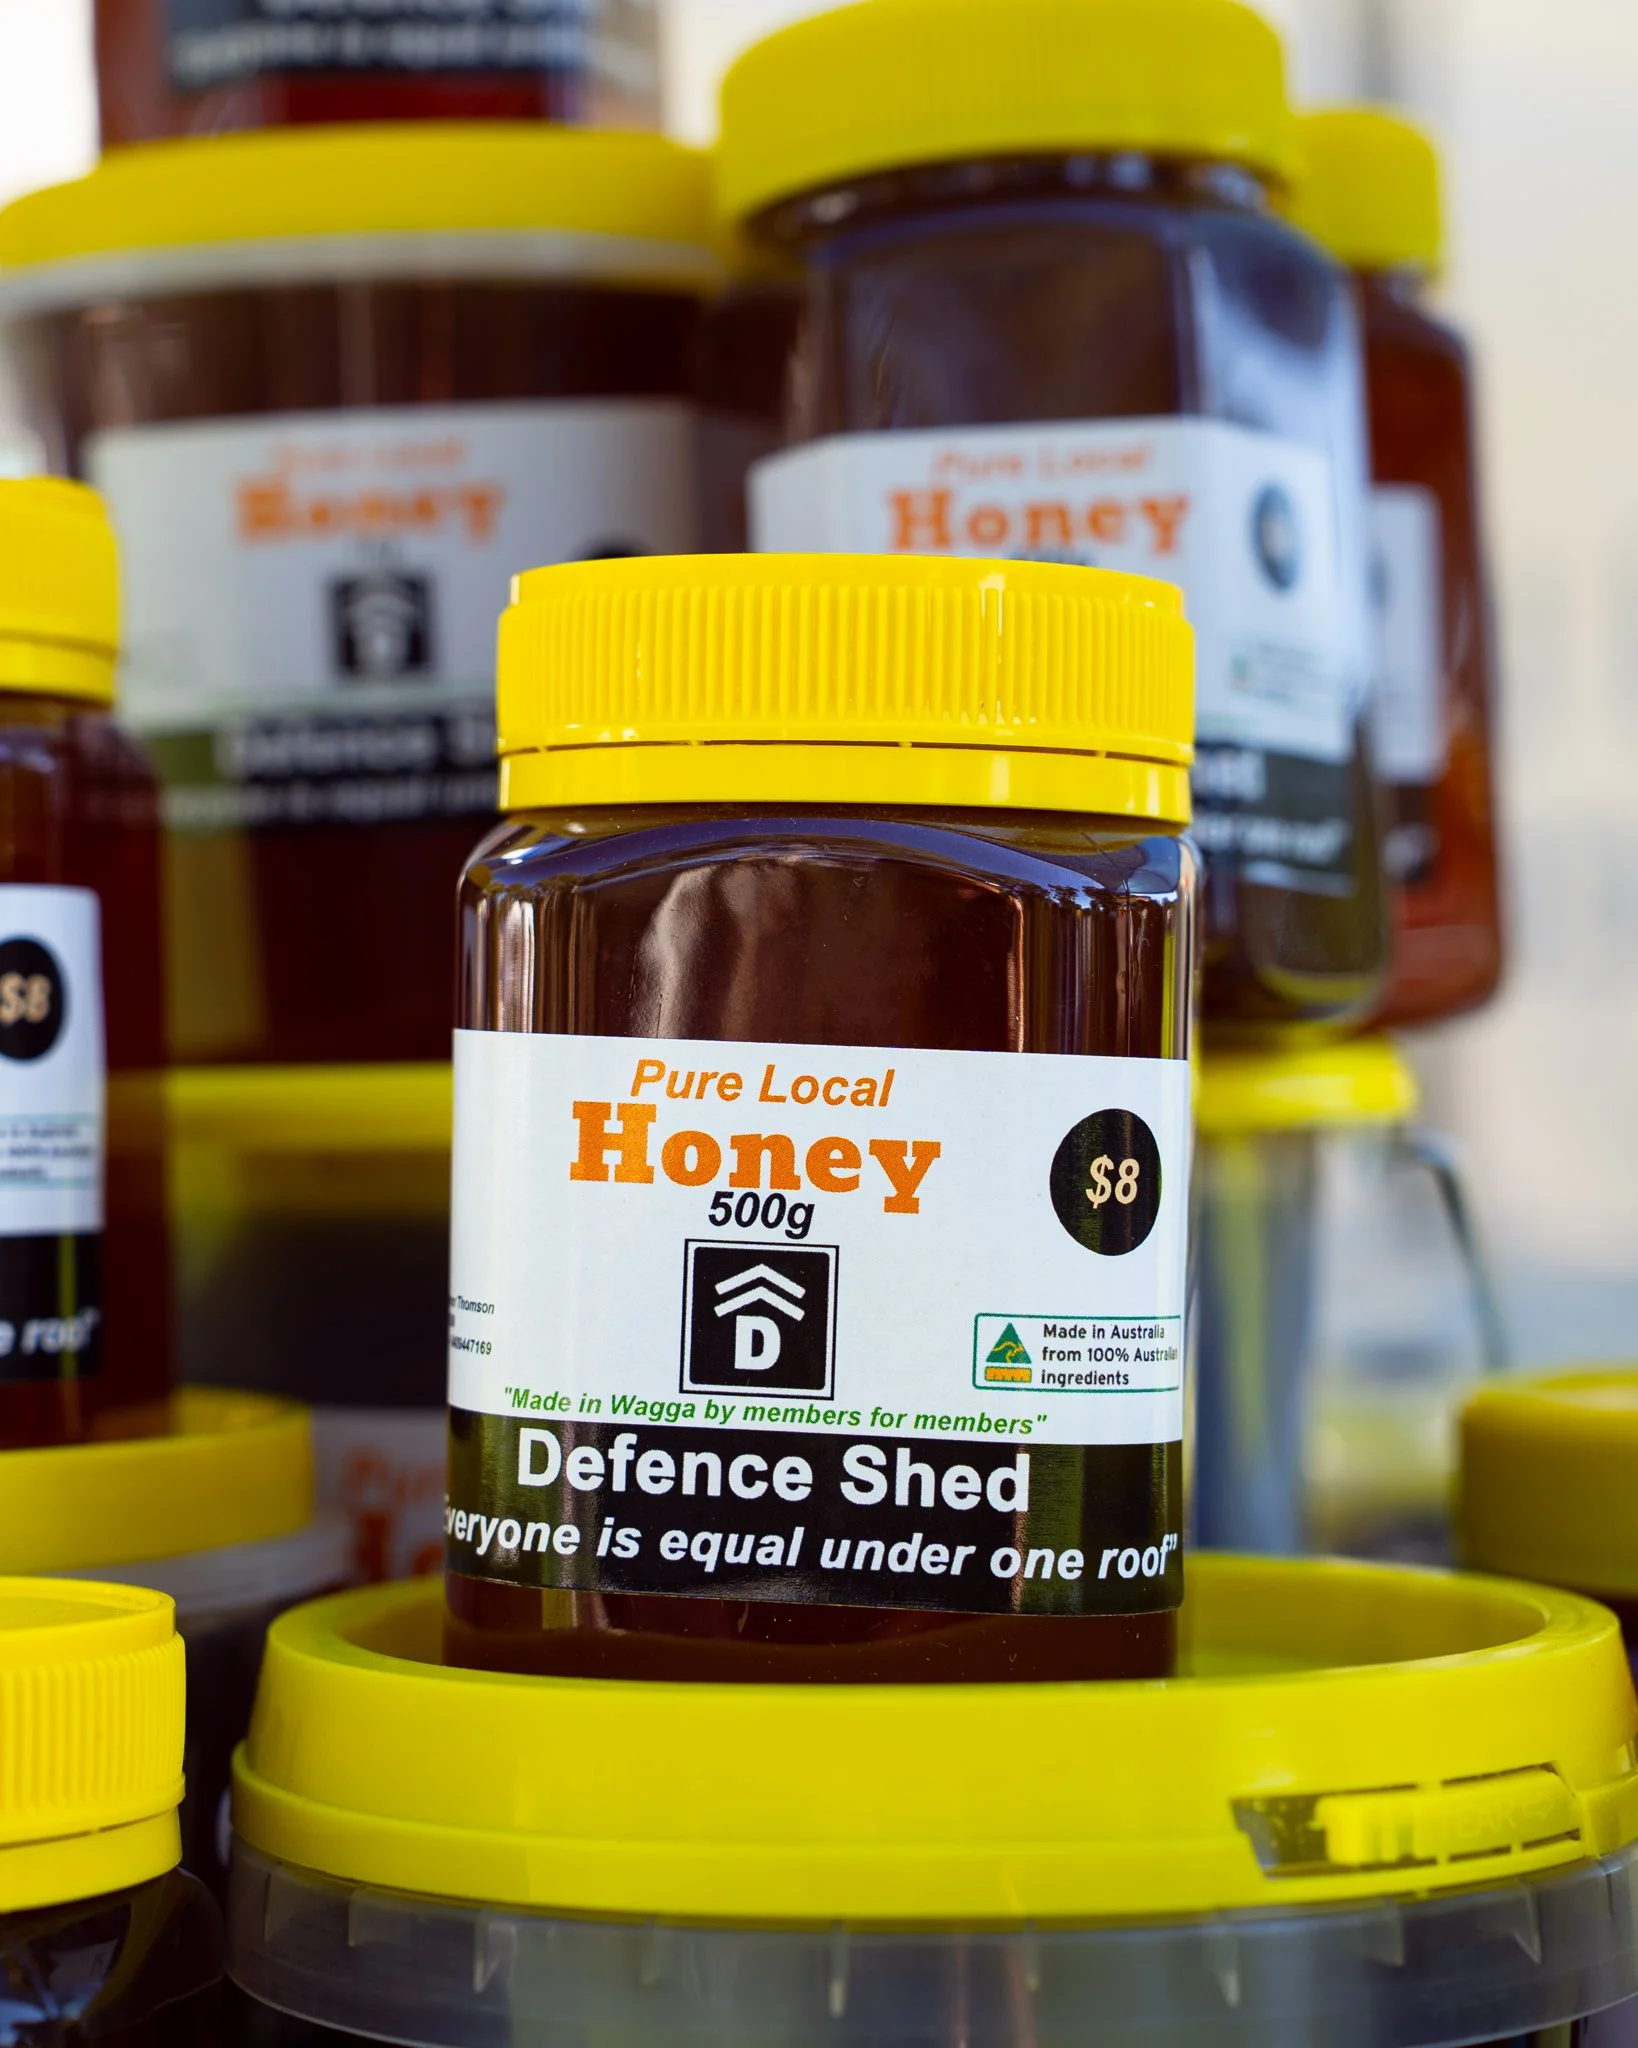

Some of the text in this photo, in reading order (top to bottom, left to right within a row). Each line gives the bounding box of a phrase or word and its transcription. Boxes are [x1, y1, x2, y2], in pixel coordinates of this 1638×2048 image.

[888, 488, 1189, 557] Honey
[630, 1058, 895, 1108] Pure Local
[569, 1100, 941, 1214] Honey
[1085, 1154, 1140, 1209] $8
[708, 1190, 815, 1240] 500g
[733, 1314, 781, 1371] D
[1042, 1346, 1081, 1362] from
[1087, 1347, 1129, 1362] 100%
[1043, 1323, 1165, 1340] Made in Australia
[1041, 1369, 1129, 1388] ingredients
[504, 1386, 1048, 1435] "Made in Wagga by members for members"
[517, 1427, 814, 1502] Defence
[840, 1443, 1030, 1513] Shed
[445, 1494, 581, 1556] veryone
[596, 1516, 642, 1559] is
[659, 1526, 805, 1573] equal
[819, 1532, 976, 1576] under
[990, 1546, 1084, 1580] one
